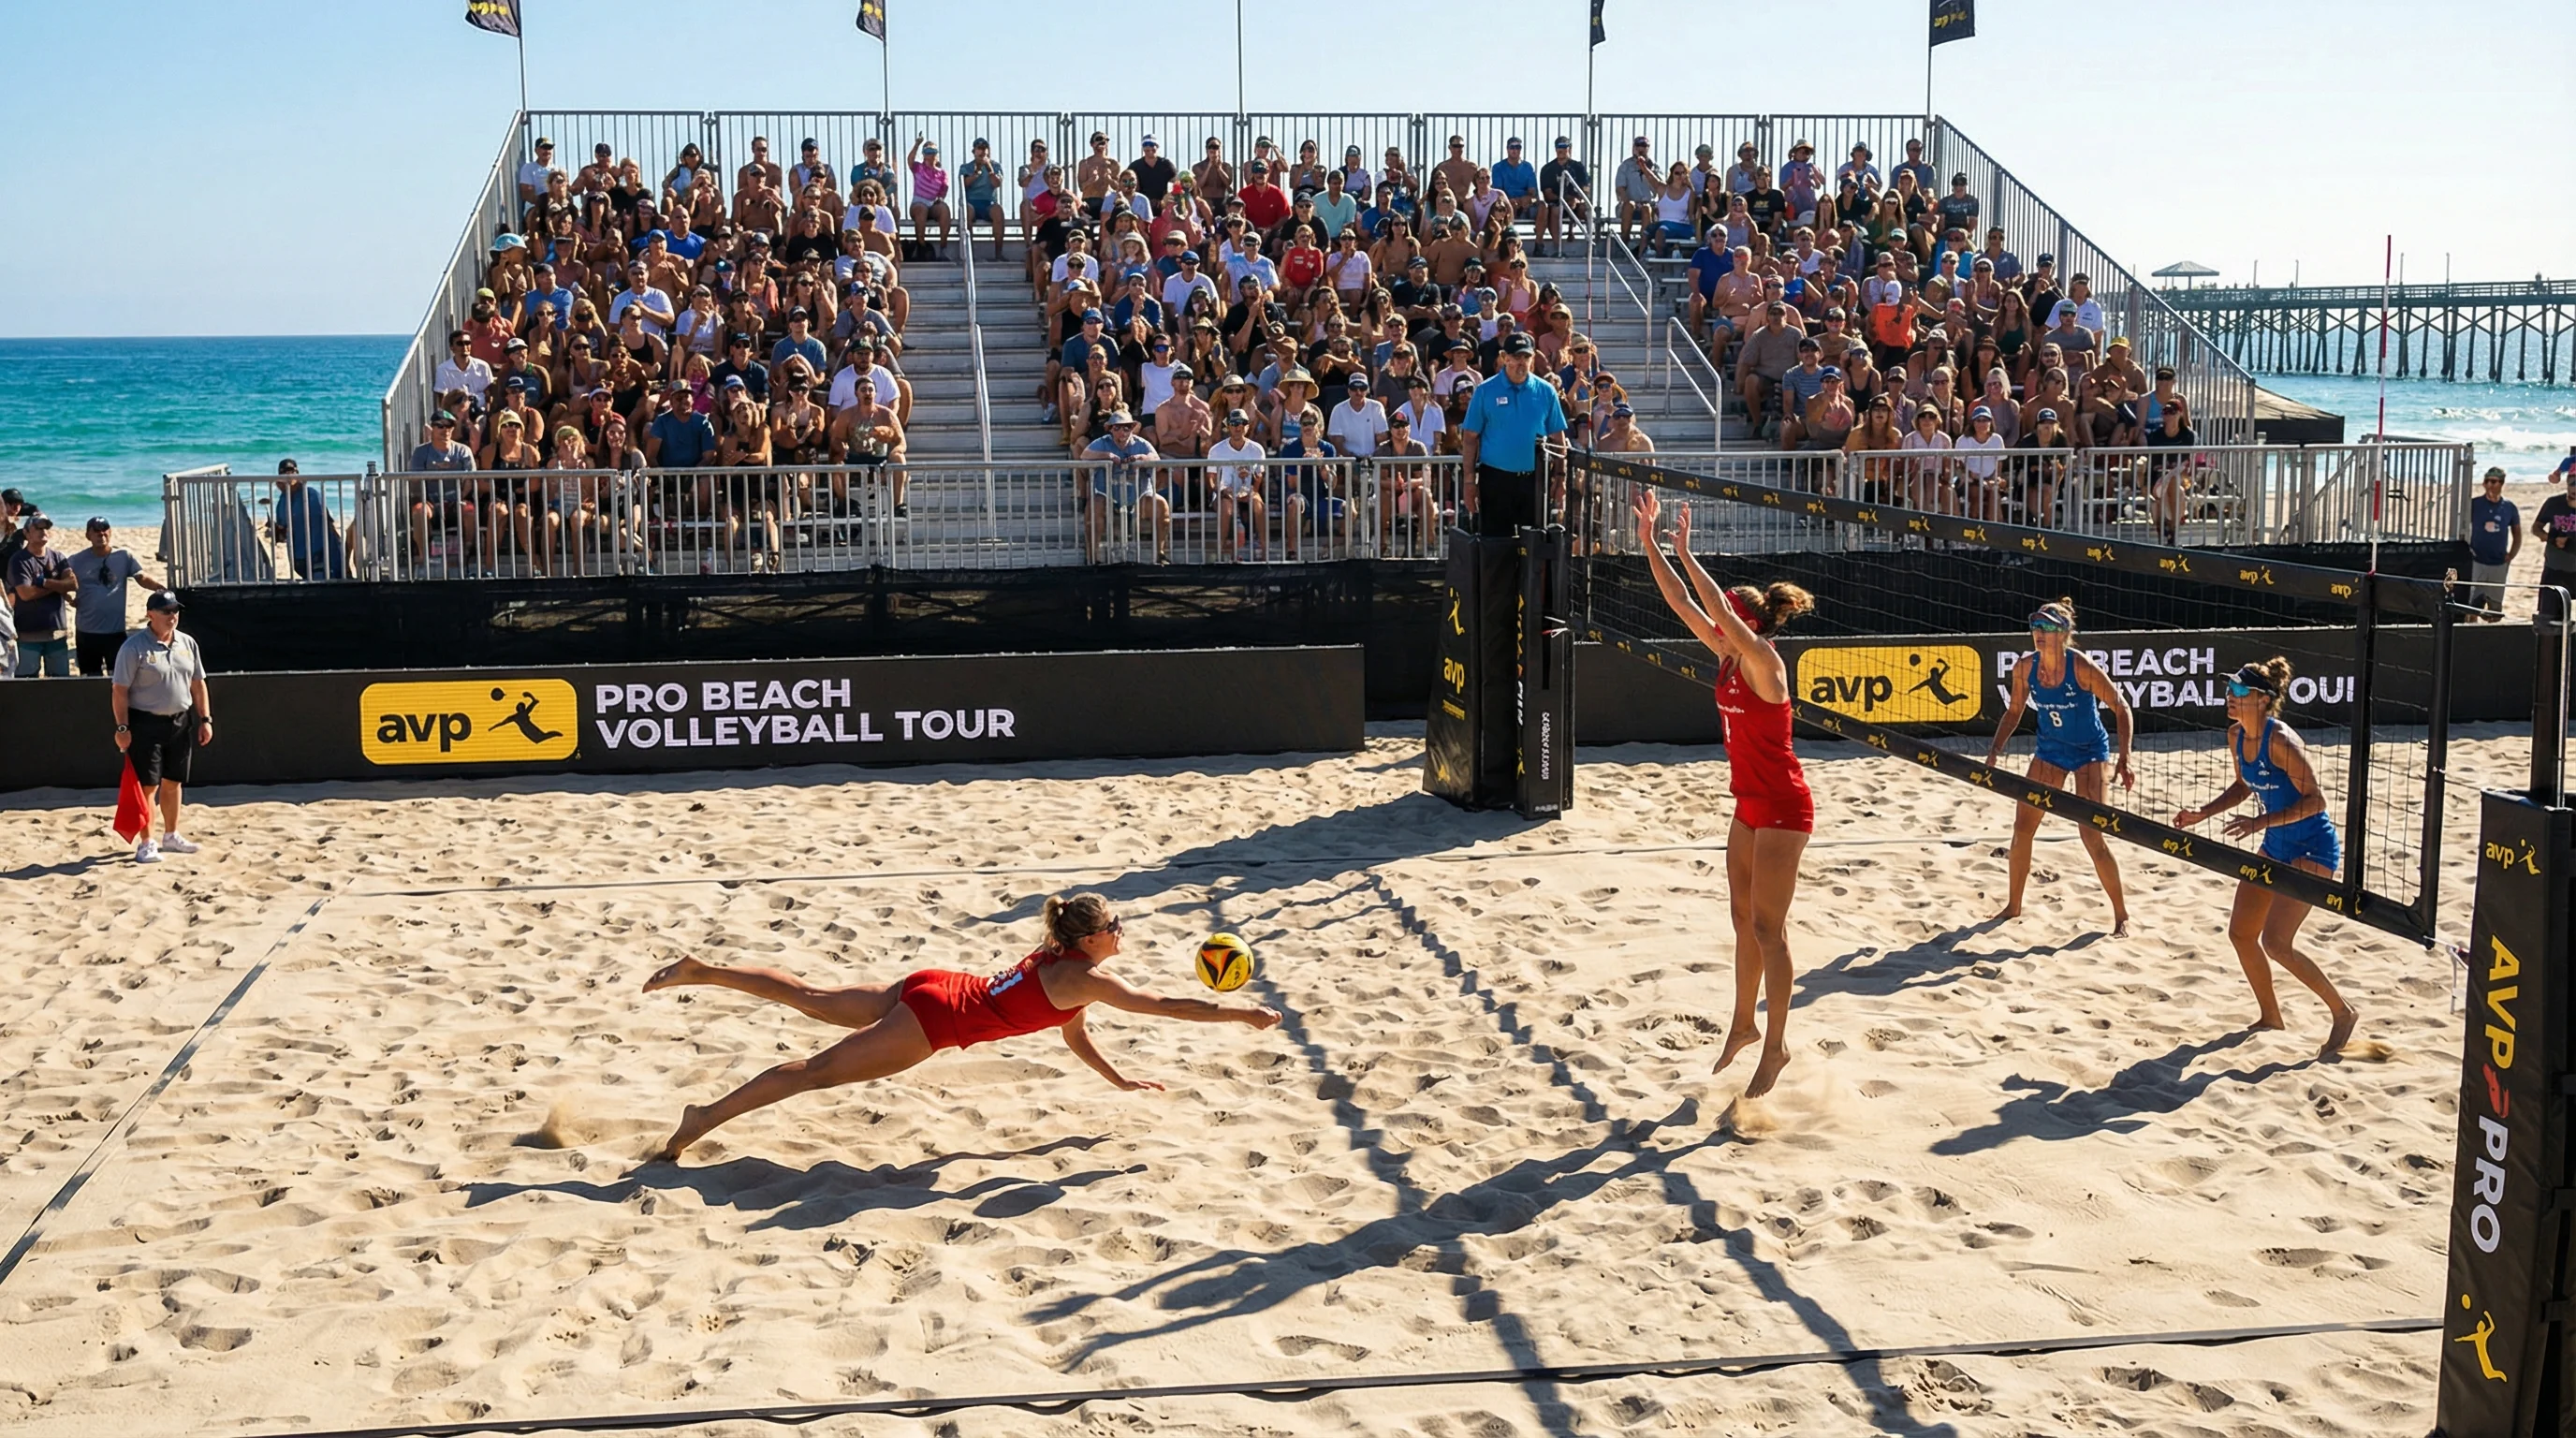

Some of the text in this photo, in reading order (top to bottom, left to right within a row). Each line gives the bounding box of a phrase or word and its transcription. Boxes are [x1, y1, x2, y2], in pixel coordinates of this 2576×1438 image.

[2331, 582, 2352, 598] avp
[1444, 657, 1464, 694] avp
[1810, 675, 1893, 712] avp
[596, 679, 851, 713] PRO BEACH
[377, 713, 471, 752] avp
[595, 709, 1016, 749] VOLLEYBALL TOUR
[2049, 711, 2063, 727] 8
[2485, 843, 2515, 869] avp
[2470, 934, 2521, 1254] AVP PRO
